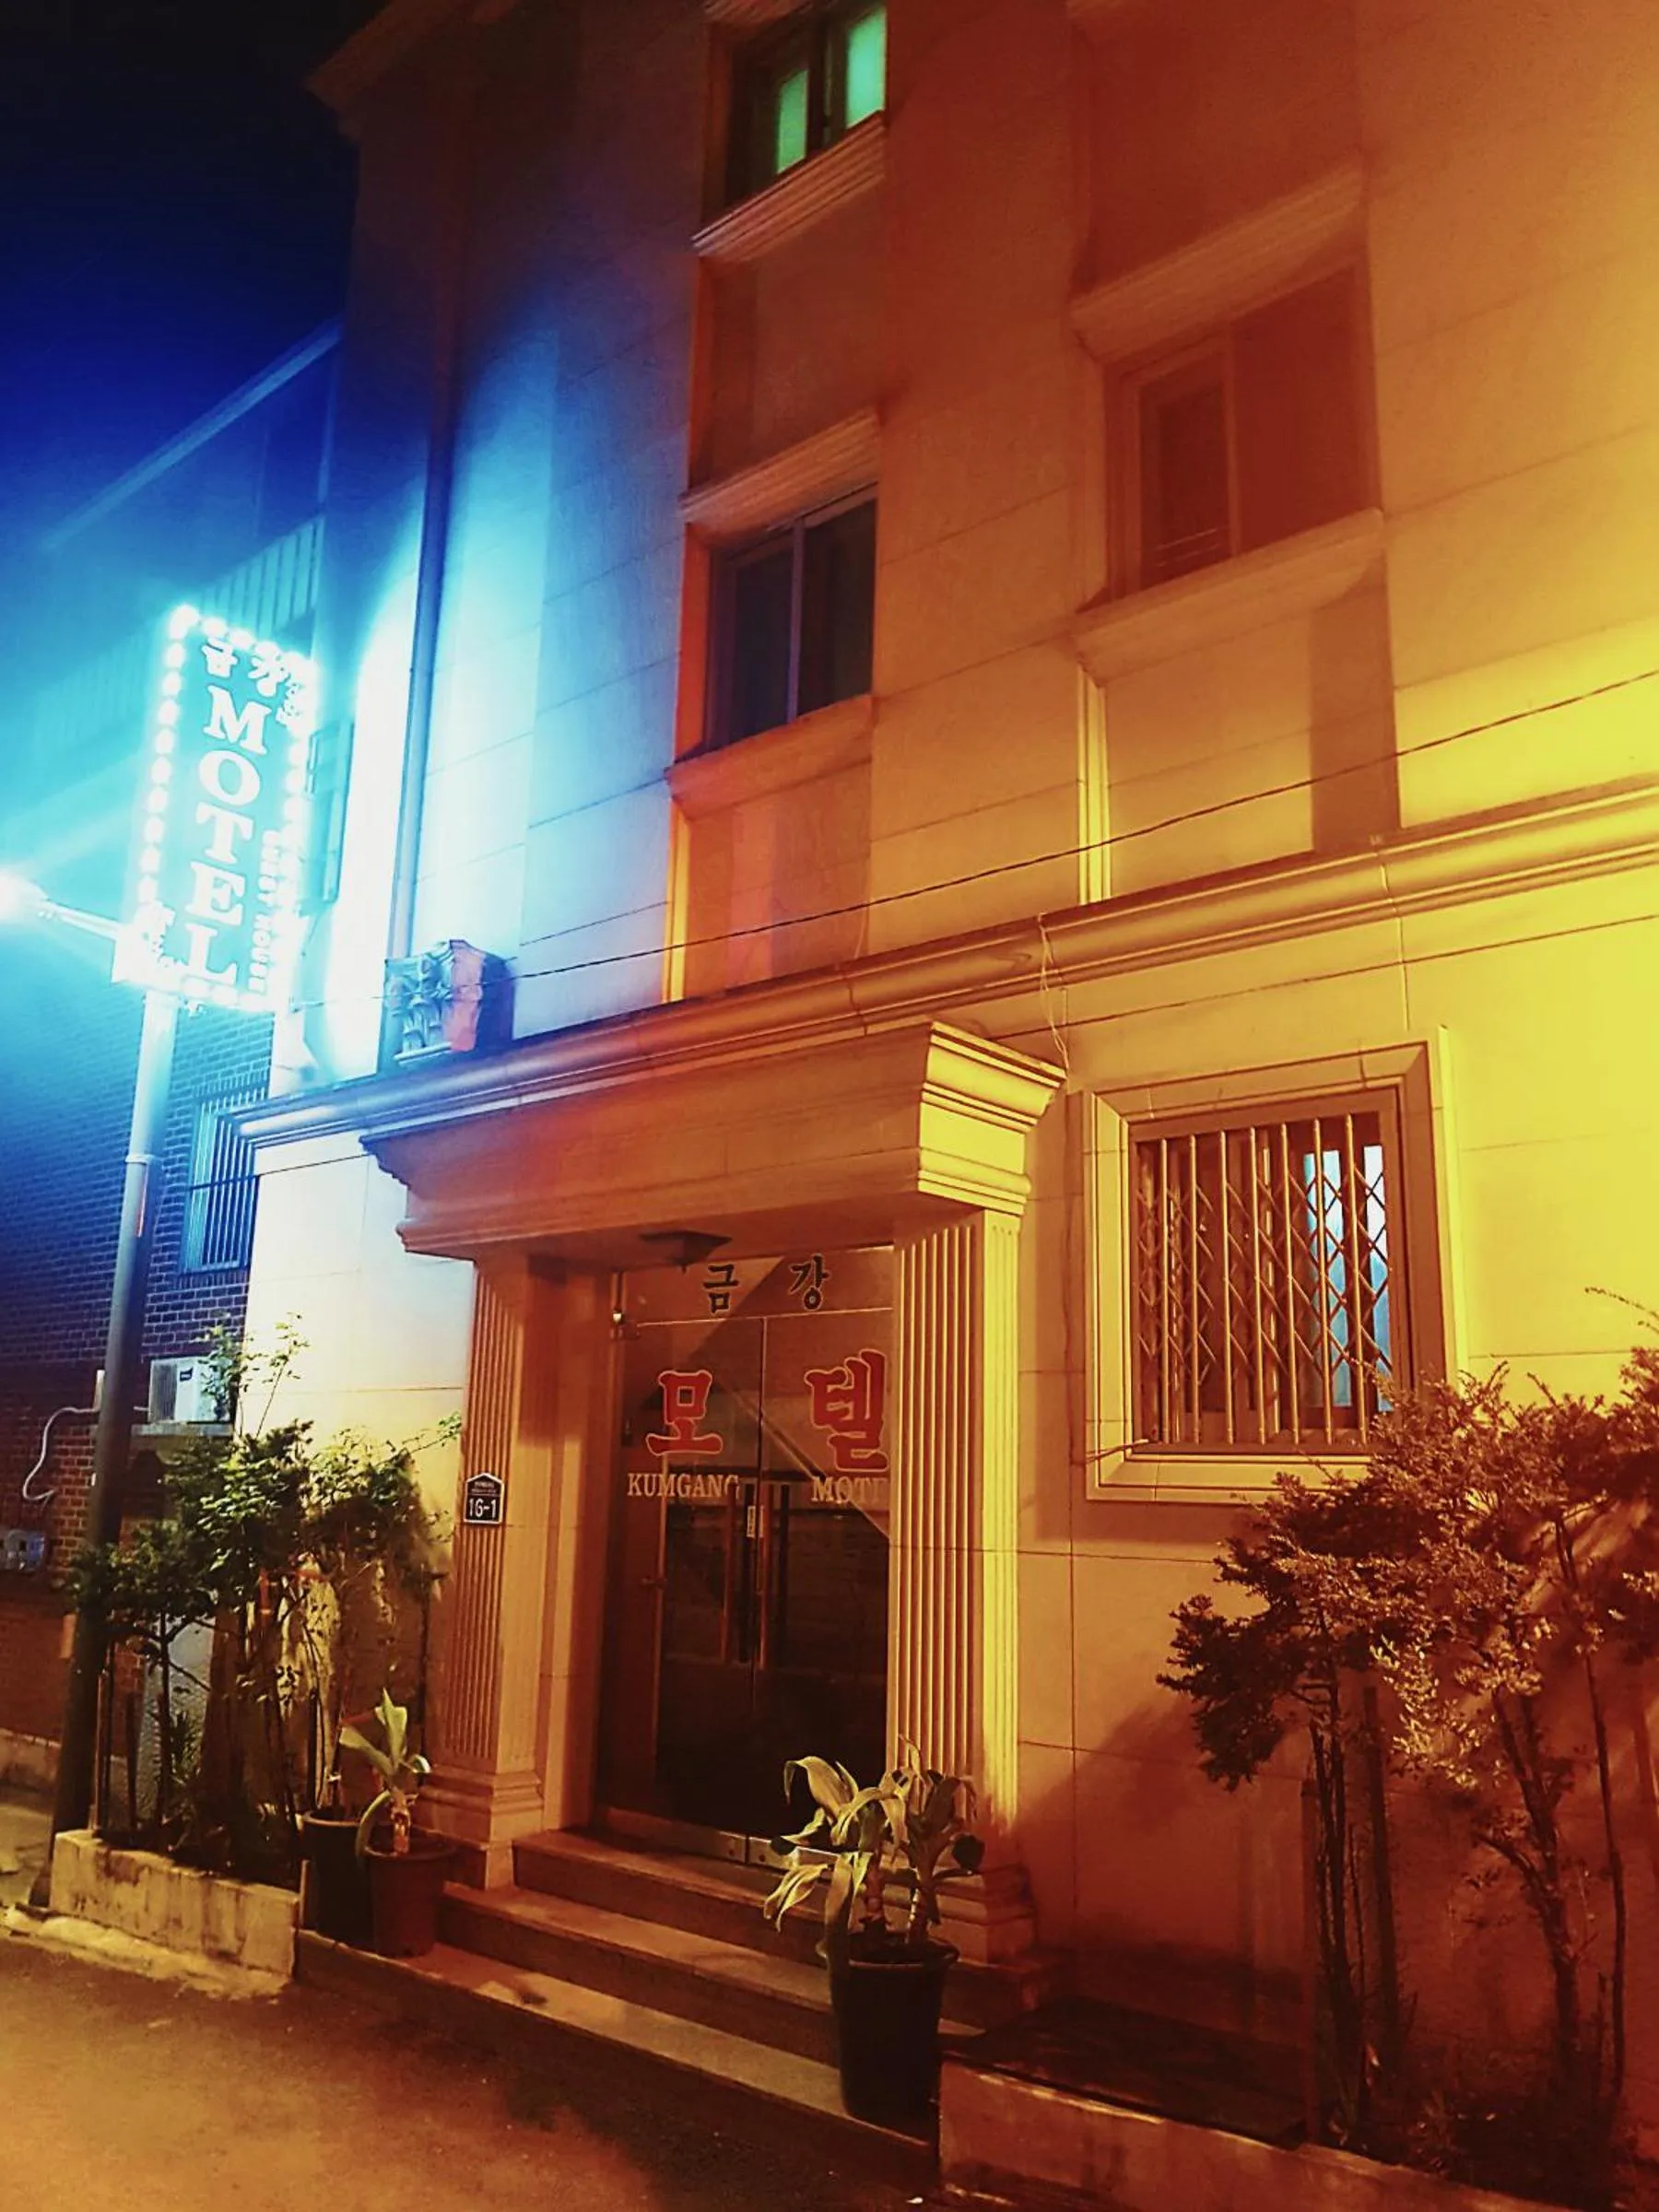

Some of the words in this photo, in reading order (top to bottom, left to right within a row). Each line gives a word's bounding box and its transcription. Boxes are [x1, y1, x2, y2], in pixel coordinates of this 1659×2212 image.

[184, 685, 272, 985] MOTEL
[702, 1253, 829, 1315] 금강
[645, 1348, 889, 1472] 모텔
[469, 1498, 496, 1518] 16-1
[627, 1473, 740, 1499] KUMGANG
[810, 1476, 890, 1504] MOTE
